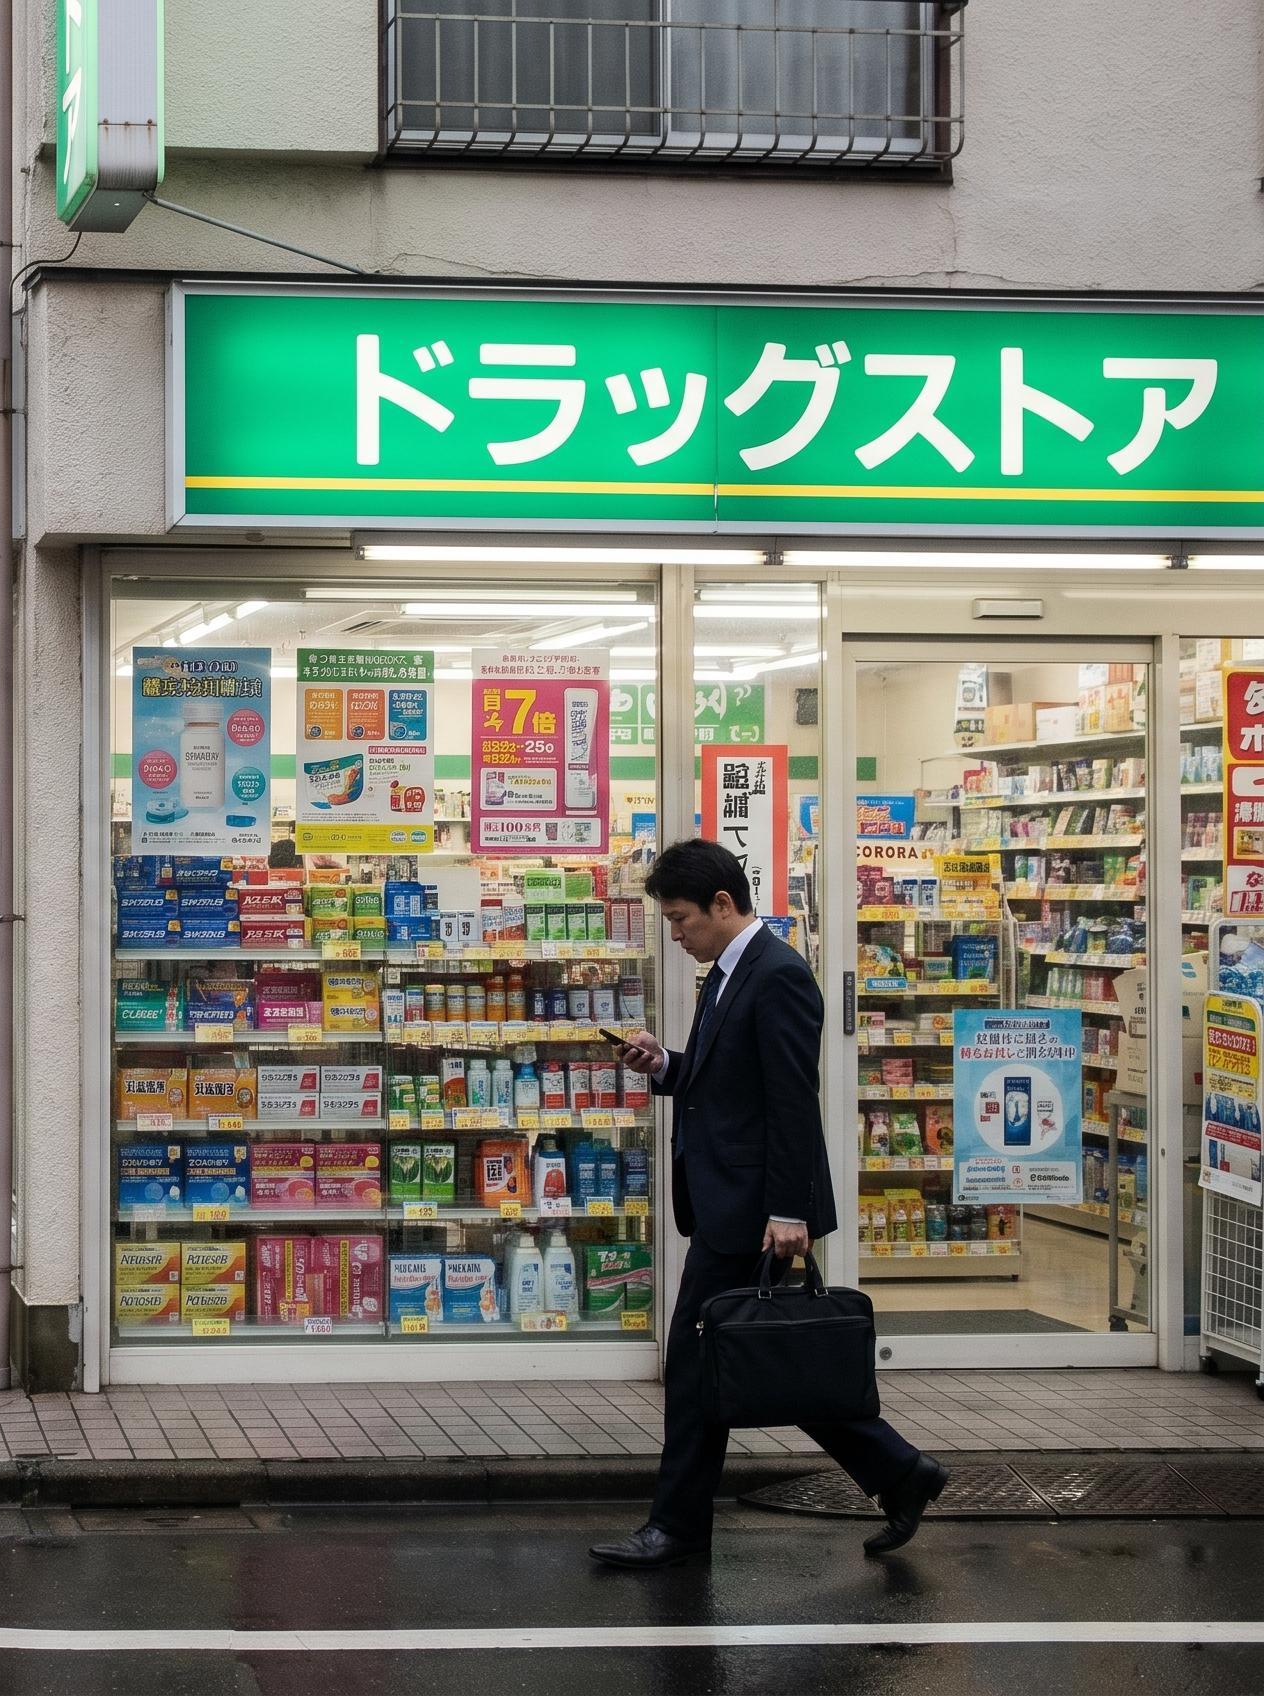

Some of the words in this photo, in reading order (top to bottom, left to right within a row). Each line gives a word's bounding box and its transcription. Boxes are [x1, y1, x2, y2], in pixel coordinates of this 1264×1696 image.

[356, 334, 1218, 475] ドラッグストア
